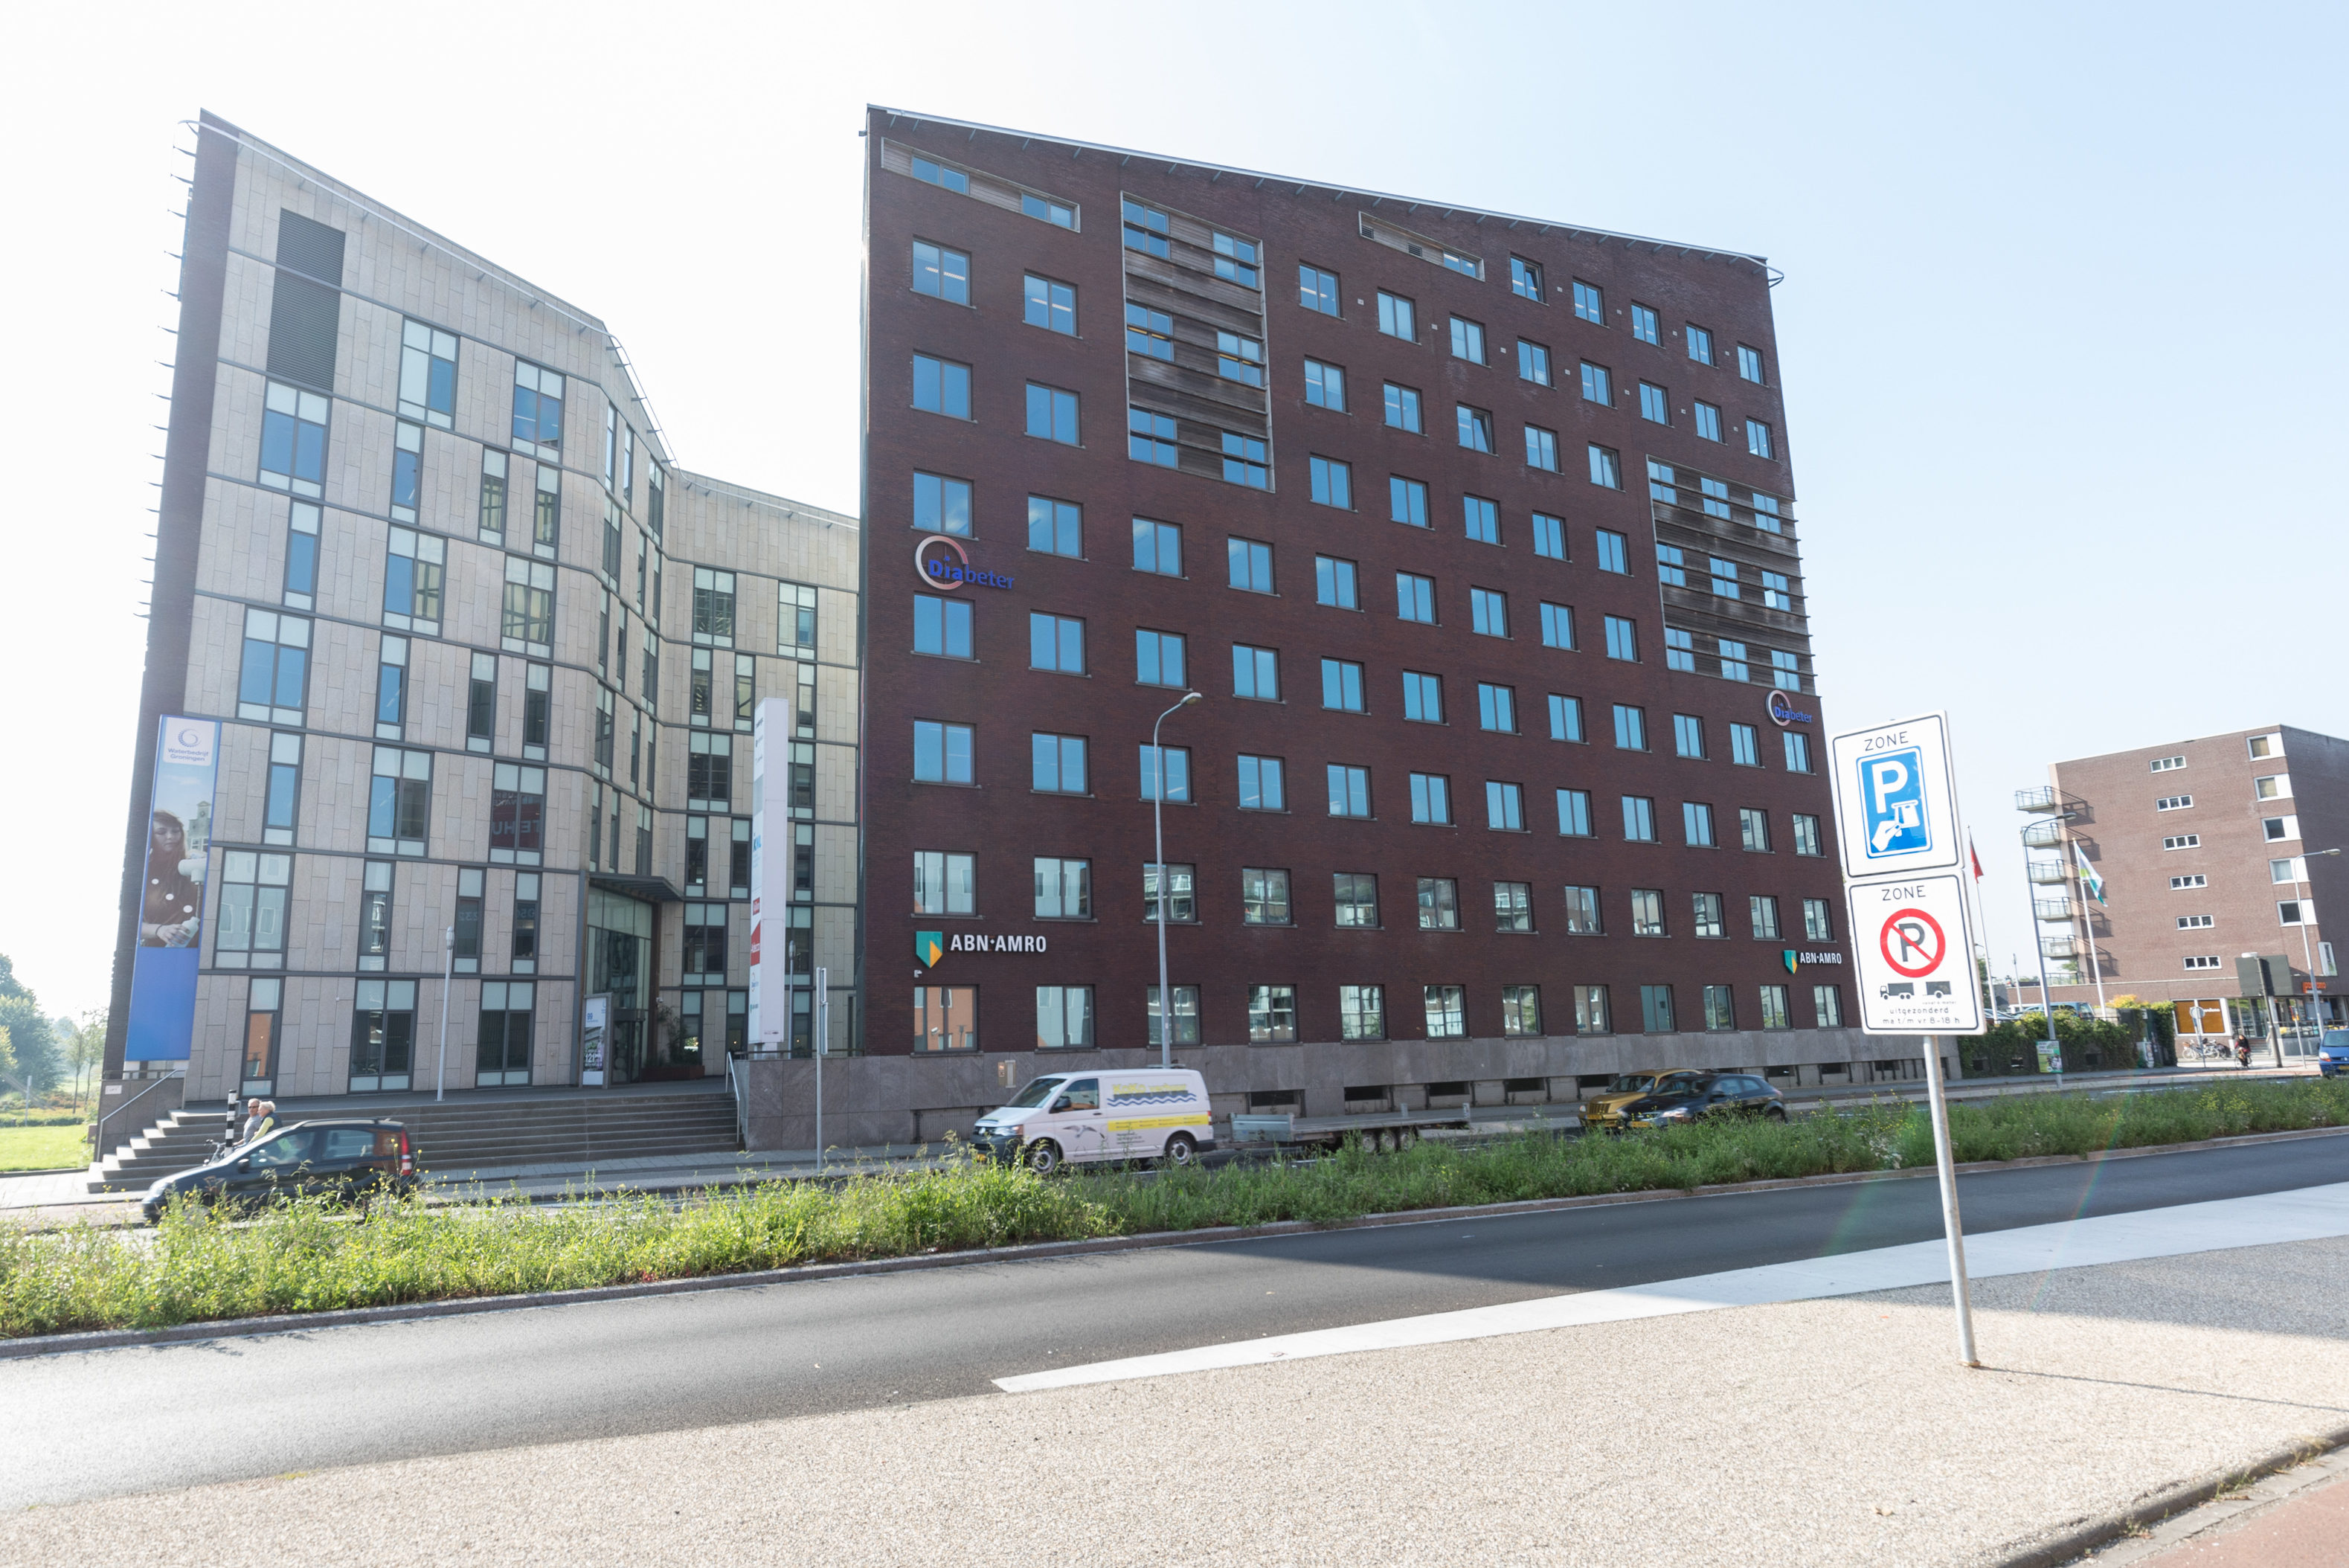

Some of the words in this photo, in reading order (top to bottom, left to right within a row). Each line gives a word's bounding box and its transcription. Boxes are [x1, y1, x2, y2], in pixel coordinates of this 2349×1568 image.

[928, 556, 1015, 589] Diabeter
[1774, 702, 1813, 723] Diabeter
[1864, 730, 1909, 751] ZONE
[167, 748, 209, 756] Waterbedrijf
[170, 754, 205, 762] Groningen
[1881, 885, 1927, 901] ZONE
[1889, 1007, 1949, 1016] uitgezonderd
